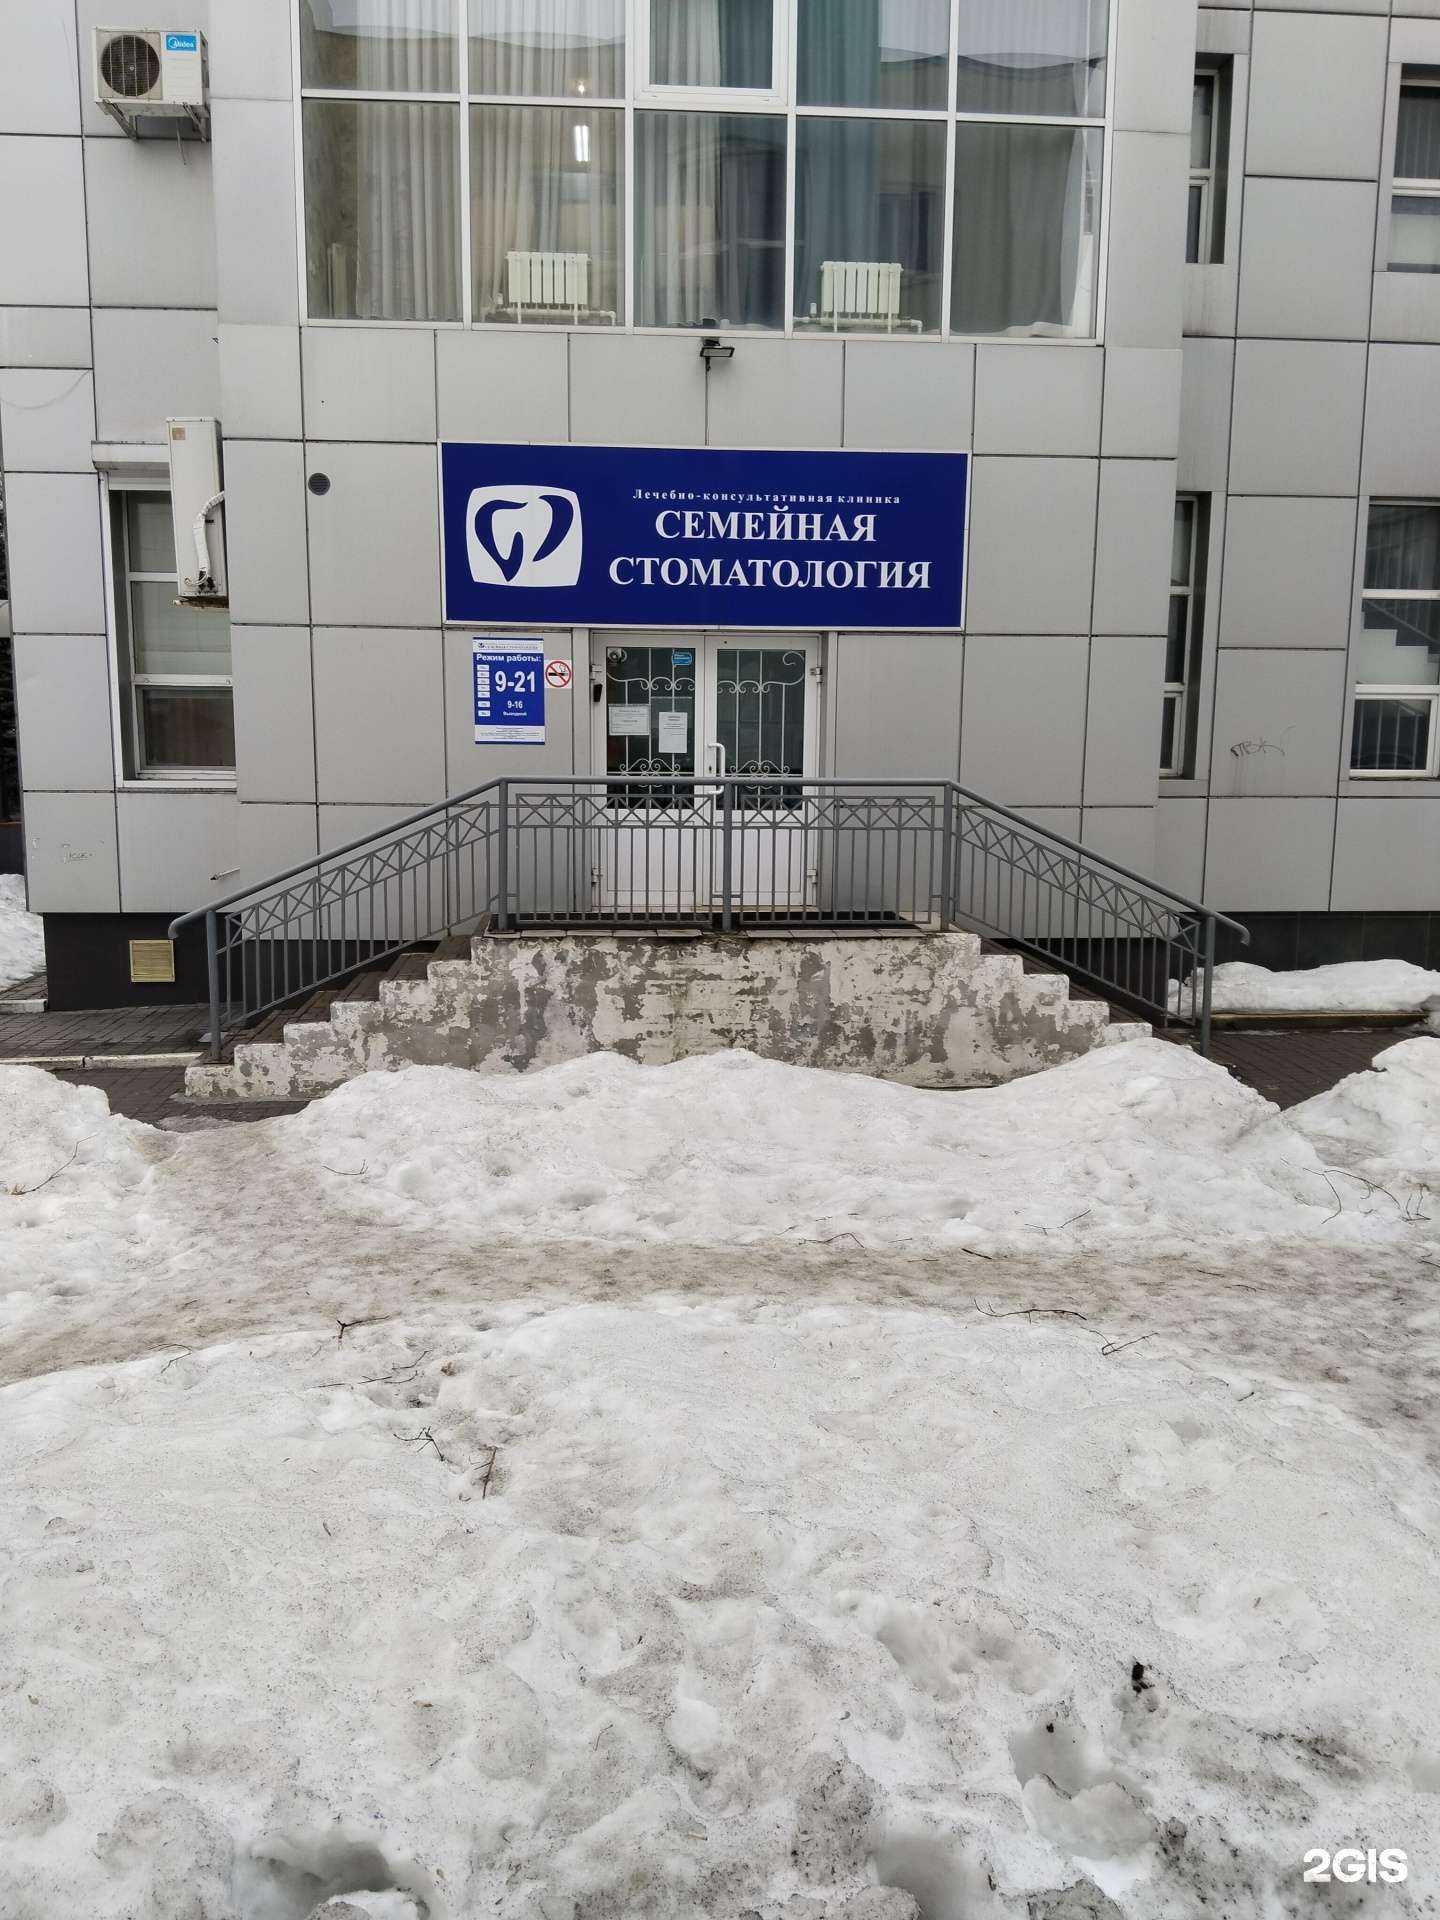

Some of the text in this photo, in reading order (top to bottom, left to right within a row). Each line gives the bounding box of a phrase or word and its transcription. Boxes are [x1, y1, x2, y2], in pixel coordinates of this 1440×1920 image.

[632, 488, 901, 504] Лечебно-консультативная клиника
[655, 504, 877, 542] СЕМЕЙНАЯ
[609, 556, 932, 589] СТОМАТОЛОГИЯ
[476, 653, 541, 662] Режим работы:
[494, 670, 535, 692] 9-21
[507, 700, 523, 709] 9-16
